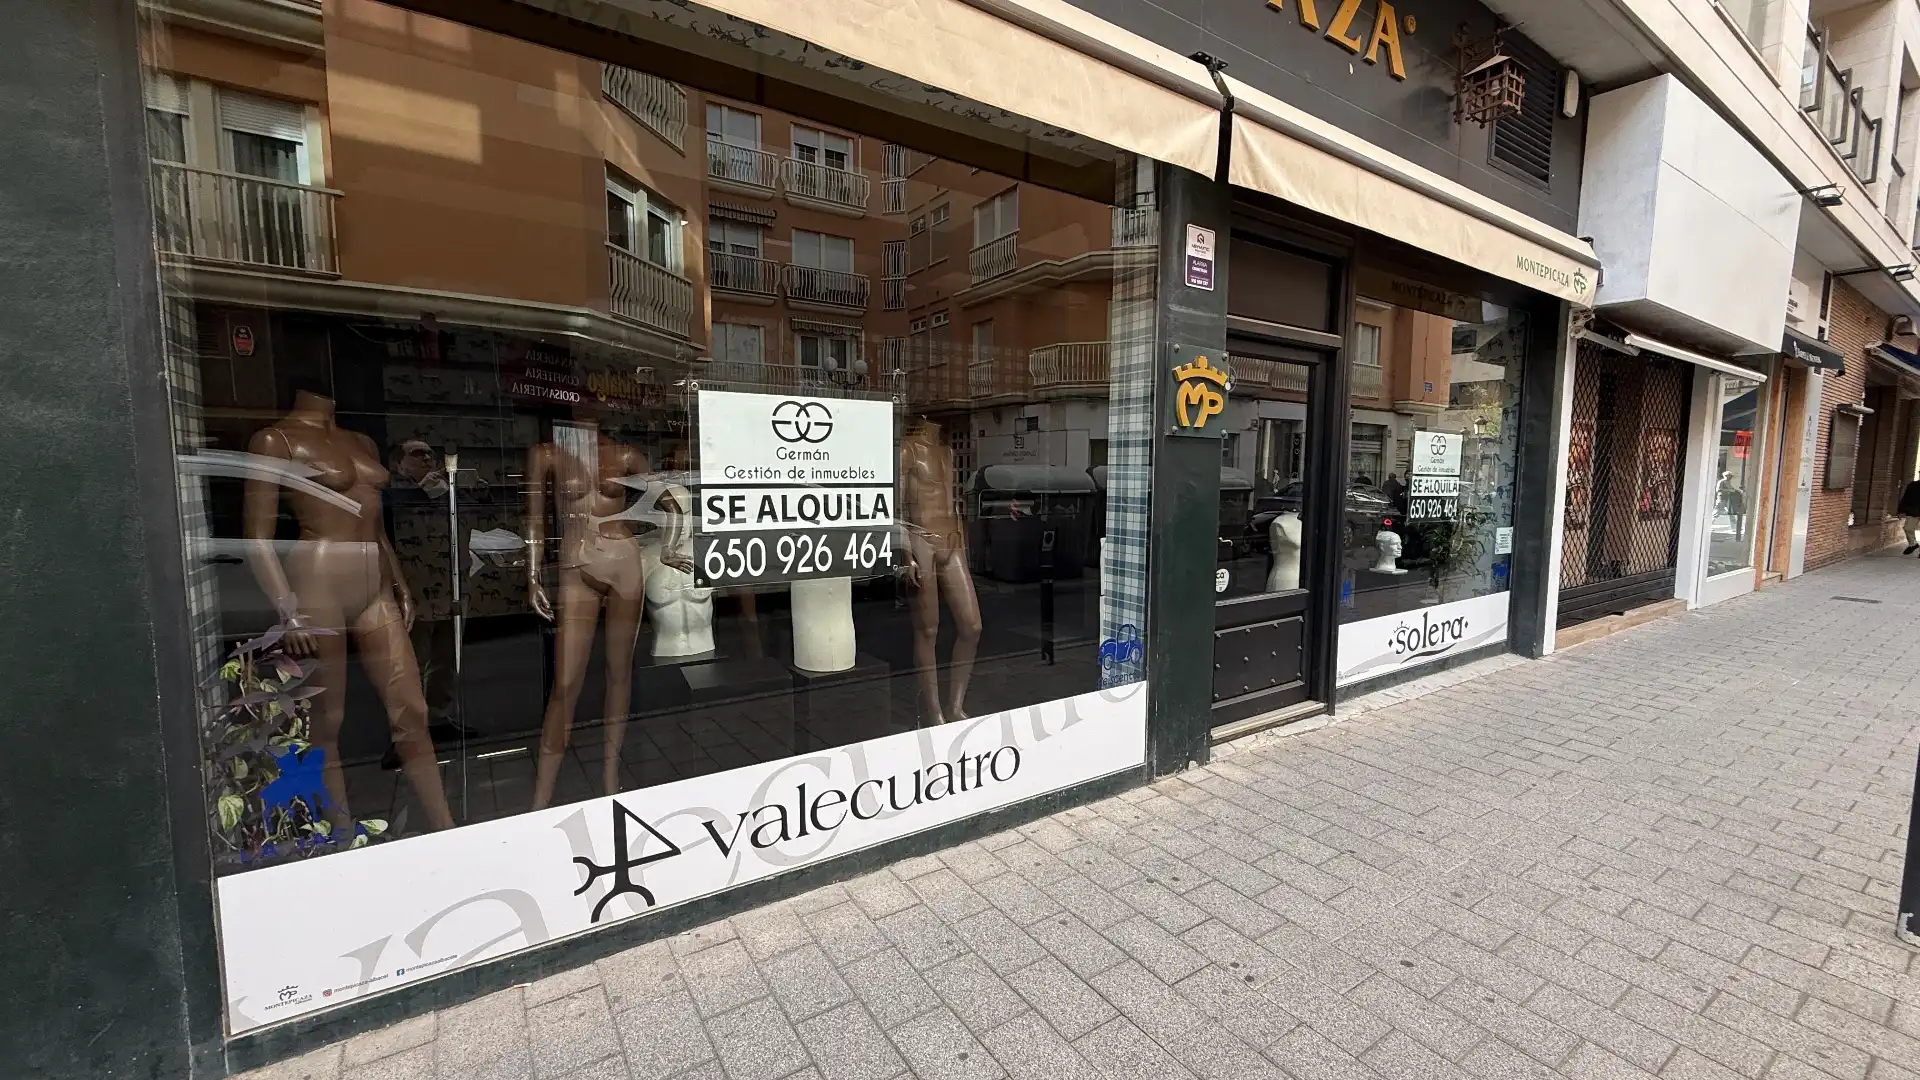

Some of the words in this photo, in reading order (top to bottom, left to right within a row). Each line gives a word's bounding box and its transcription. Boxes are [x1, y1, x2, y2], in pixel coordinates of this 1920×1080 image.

[1516, 254, 1570, 287] MONTEPICAZA
[776, 446, 830, 461] Germán
[724, 465, 781, 480] Gestión
[787, 466, 806, 480] de
[811, 466, 876, 480] inmuebles
[1412, 478, 1423, 494] SE
[1424, 478, 1458, 495] ALQUILA
[706, 495, 747, 526] SE
[756, 493, 890, 525] ALQUILA
[1410, 499, 1426, 519] 650
[1427, 498, 1442, 518] 926
[1443, 498, 1458, 517] 464
[704, 537, 767, 580] 650
[776, 534, 833, 575] 926
[843, 531, 893, 570] 464
[1395, 611, 1465, 655] solera
[702, 744, 1021, 859] valecuatro
